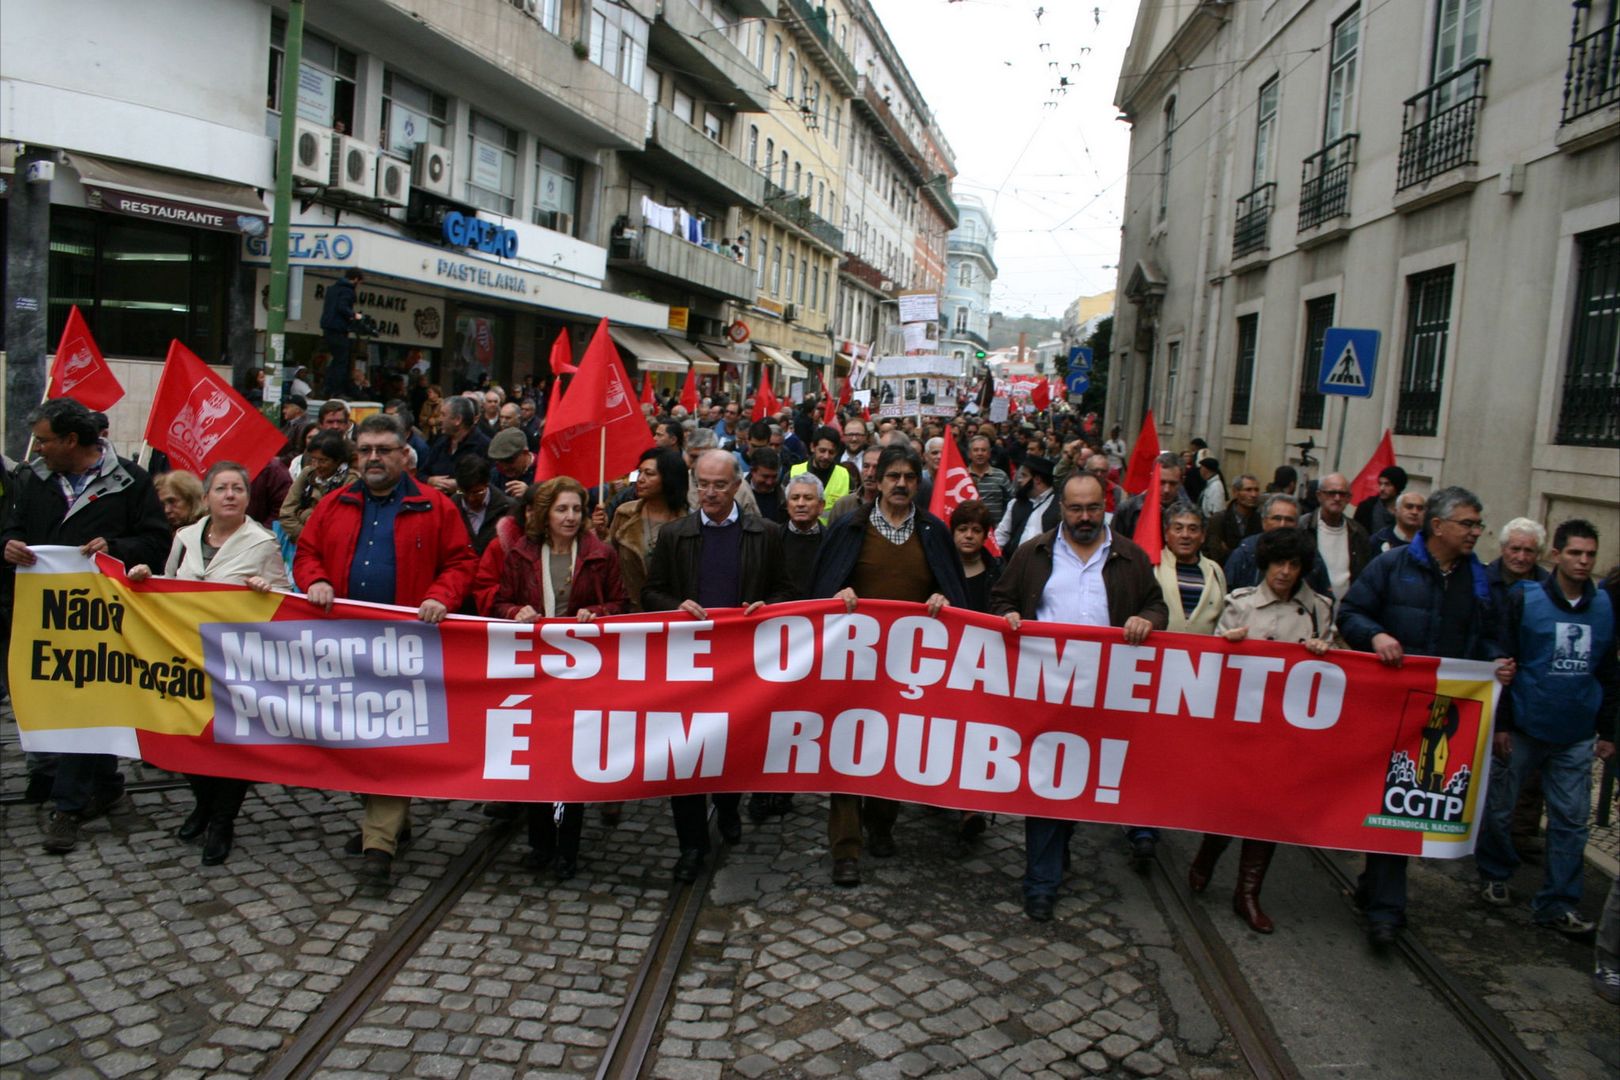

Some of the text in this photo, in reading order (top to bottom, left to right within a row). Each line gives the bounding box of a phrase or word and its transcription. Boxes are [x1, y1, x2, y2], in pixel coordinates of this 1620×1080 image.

[120, 199, 223, 227] RESTAURANTE
[246, 232, 353, 260] GLÃO
[442, 211, 519, 259] GALÃO
[437, 258, 527, 294] PASTELARIA
[315, 284, 407, 313] RURANTE
[42, 587, 109, 631] Não
[31, 640, 205, 701] Exploração
[221, 628, 424, 682] Mudar de
[486, 613, 1347, 730] ESTE ORÇAMENTO
[1553, 659, 1588, 671] CGTP
[225, 679, 429, 741] Política!
[483, 694, 1129, 804] É UM ROUBO!
[1368, 816, 1429, 830] INTERSINDICAL
[1385, 786, 1464, 821] CGTP
